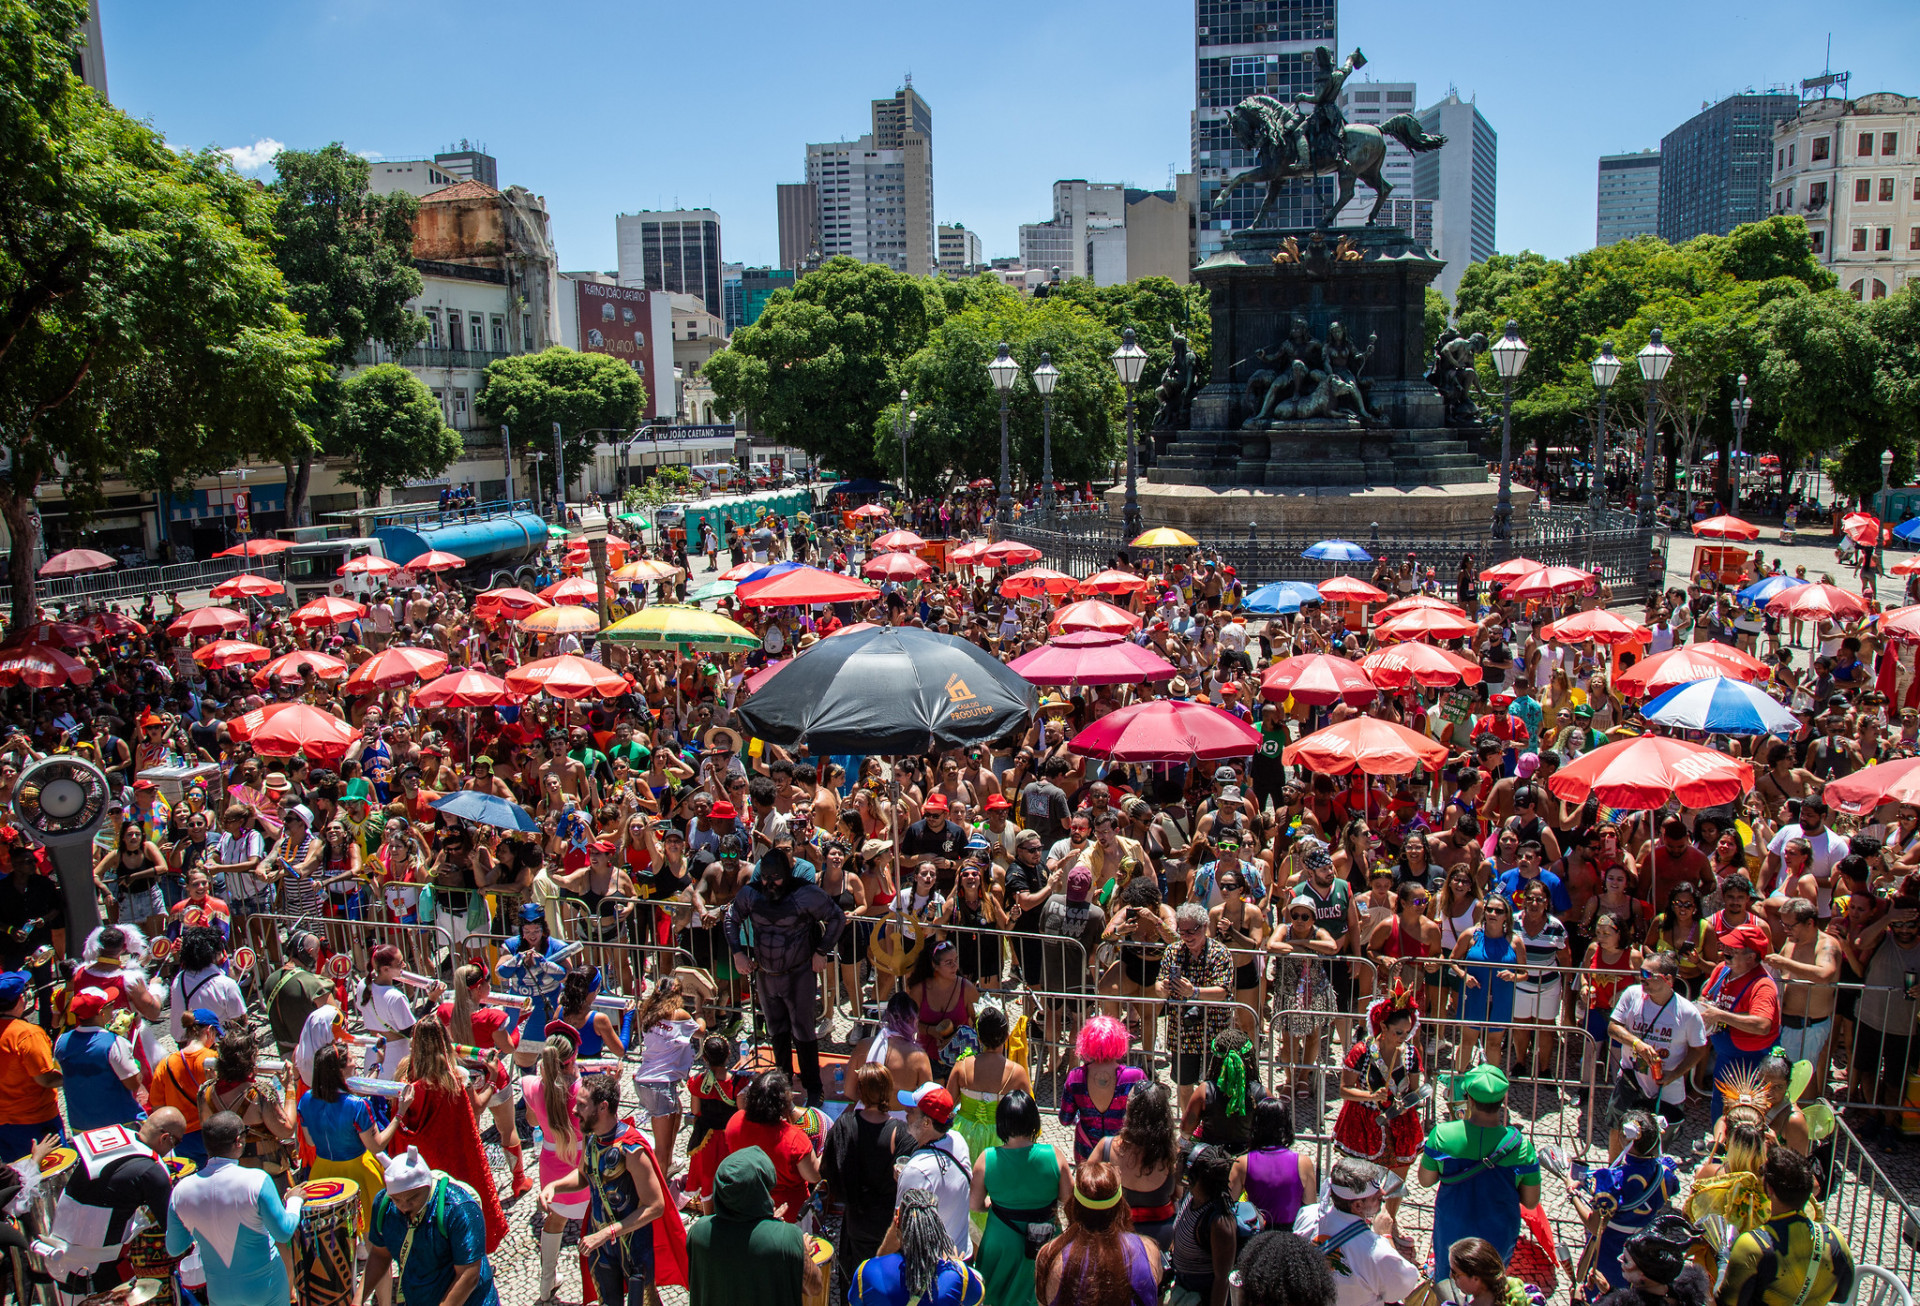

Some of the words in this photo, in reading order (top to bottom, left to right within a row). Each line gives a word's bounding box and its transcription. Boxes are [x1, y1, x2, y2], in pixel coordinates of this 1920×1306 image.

[623, 289, 646, 302] CAETANO
[617, 339, 635, 353] ANOS
[669, 428, 687, 439] JOÃO
[687, 428, 715, 438] CAETANO
[2, 658, 55, 675] BRAHMA
[1362, 652, 1409, 672] BRAHMA
[526, 667, 582, 682] BRAHMA
[1663, 664, 1723, 683] BRAHMA
[950, 705, 995, 721] PRODUTOR
[1661, 1027, 1673, 1037] DA
